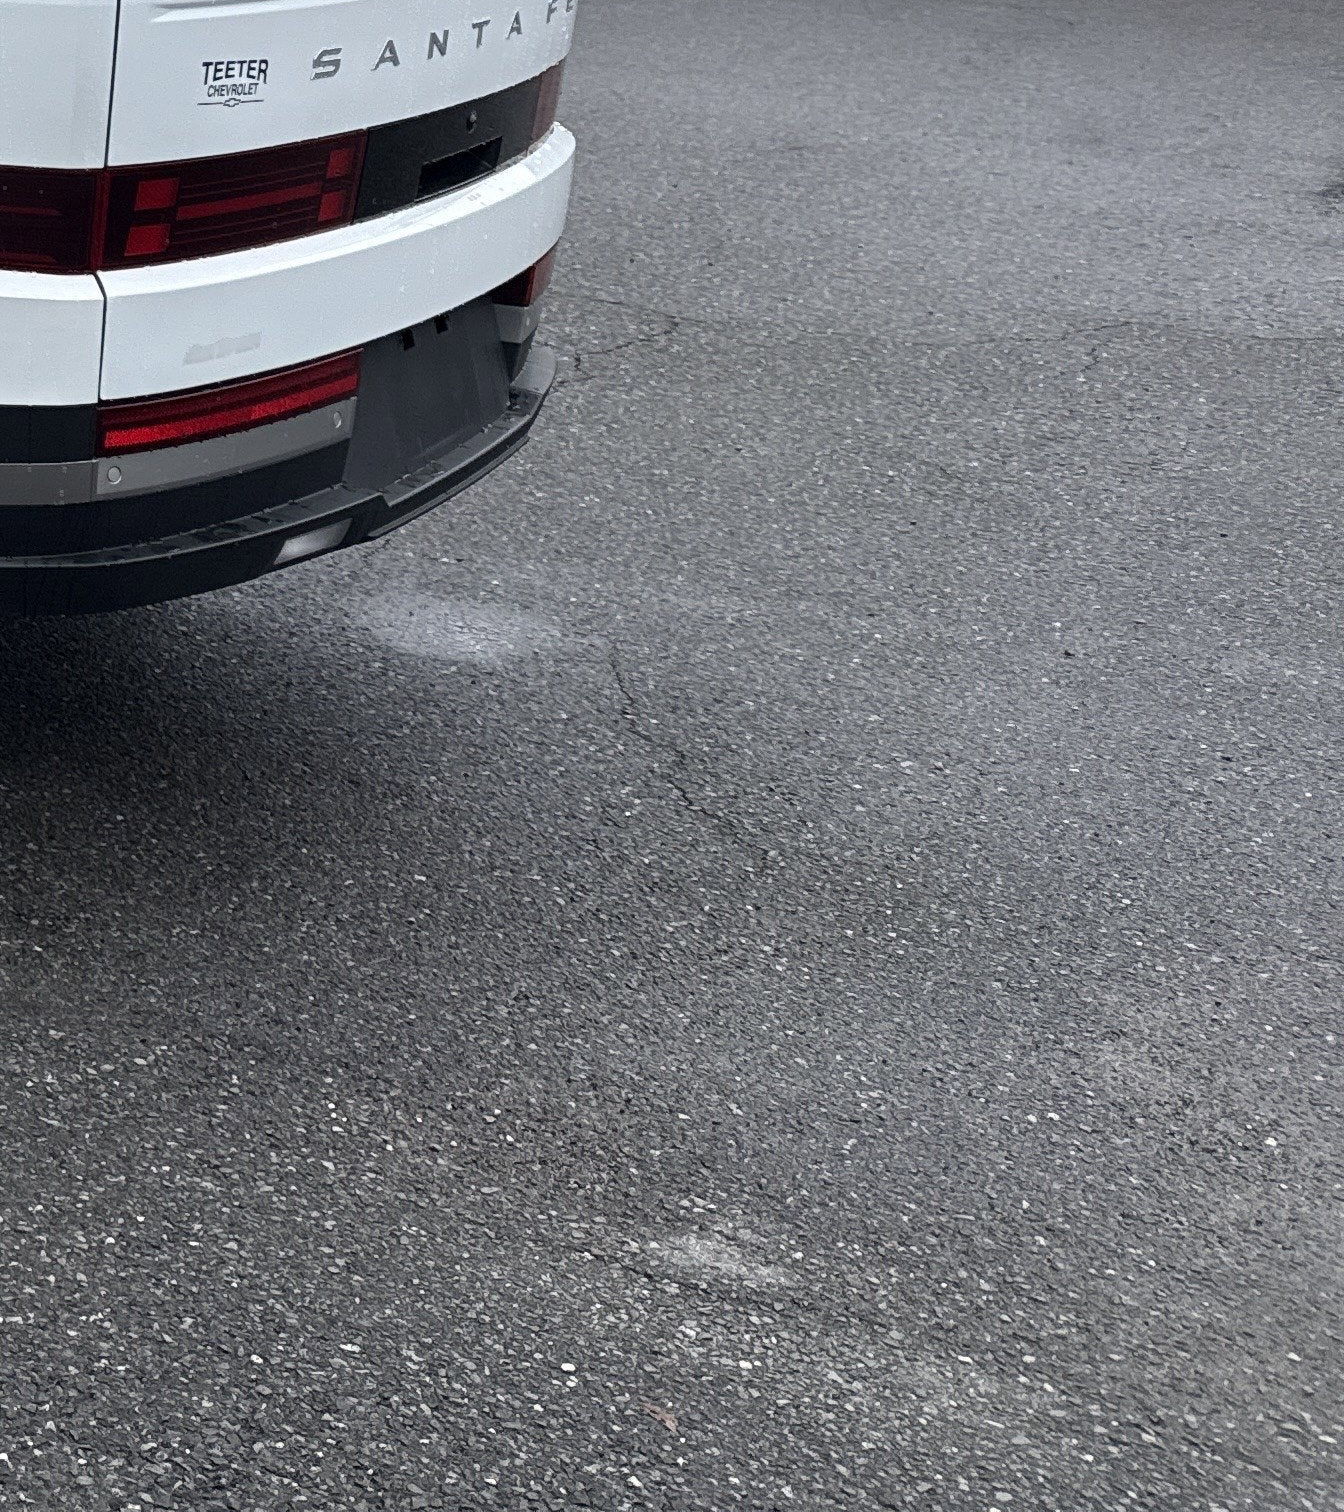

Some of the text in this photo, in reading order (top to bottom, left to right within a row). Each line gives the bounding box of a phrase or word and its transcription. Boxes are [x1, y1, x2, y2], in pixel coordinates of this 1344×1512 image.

[310, 9, 523, 81] SANTA
[202, 59, 269, 86] TEETER
[207, 82, 260, 98] CHEVROLET
